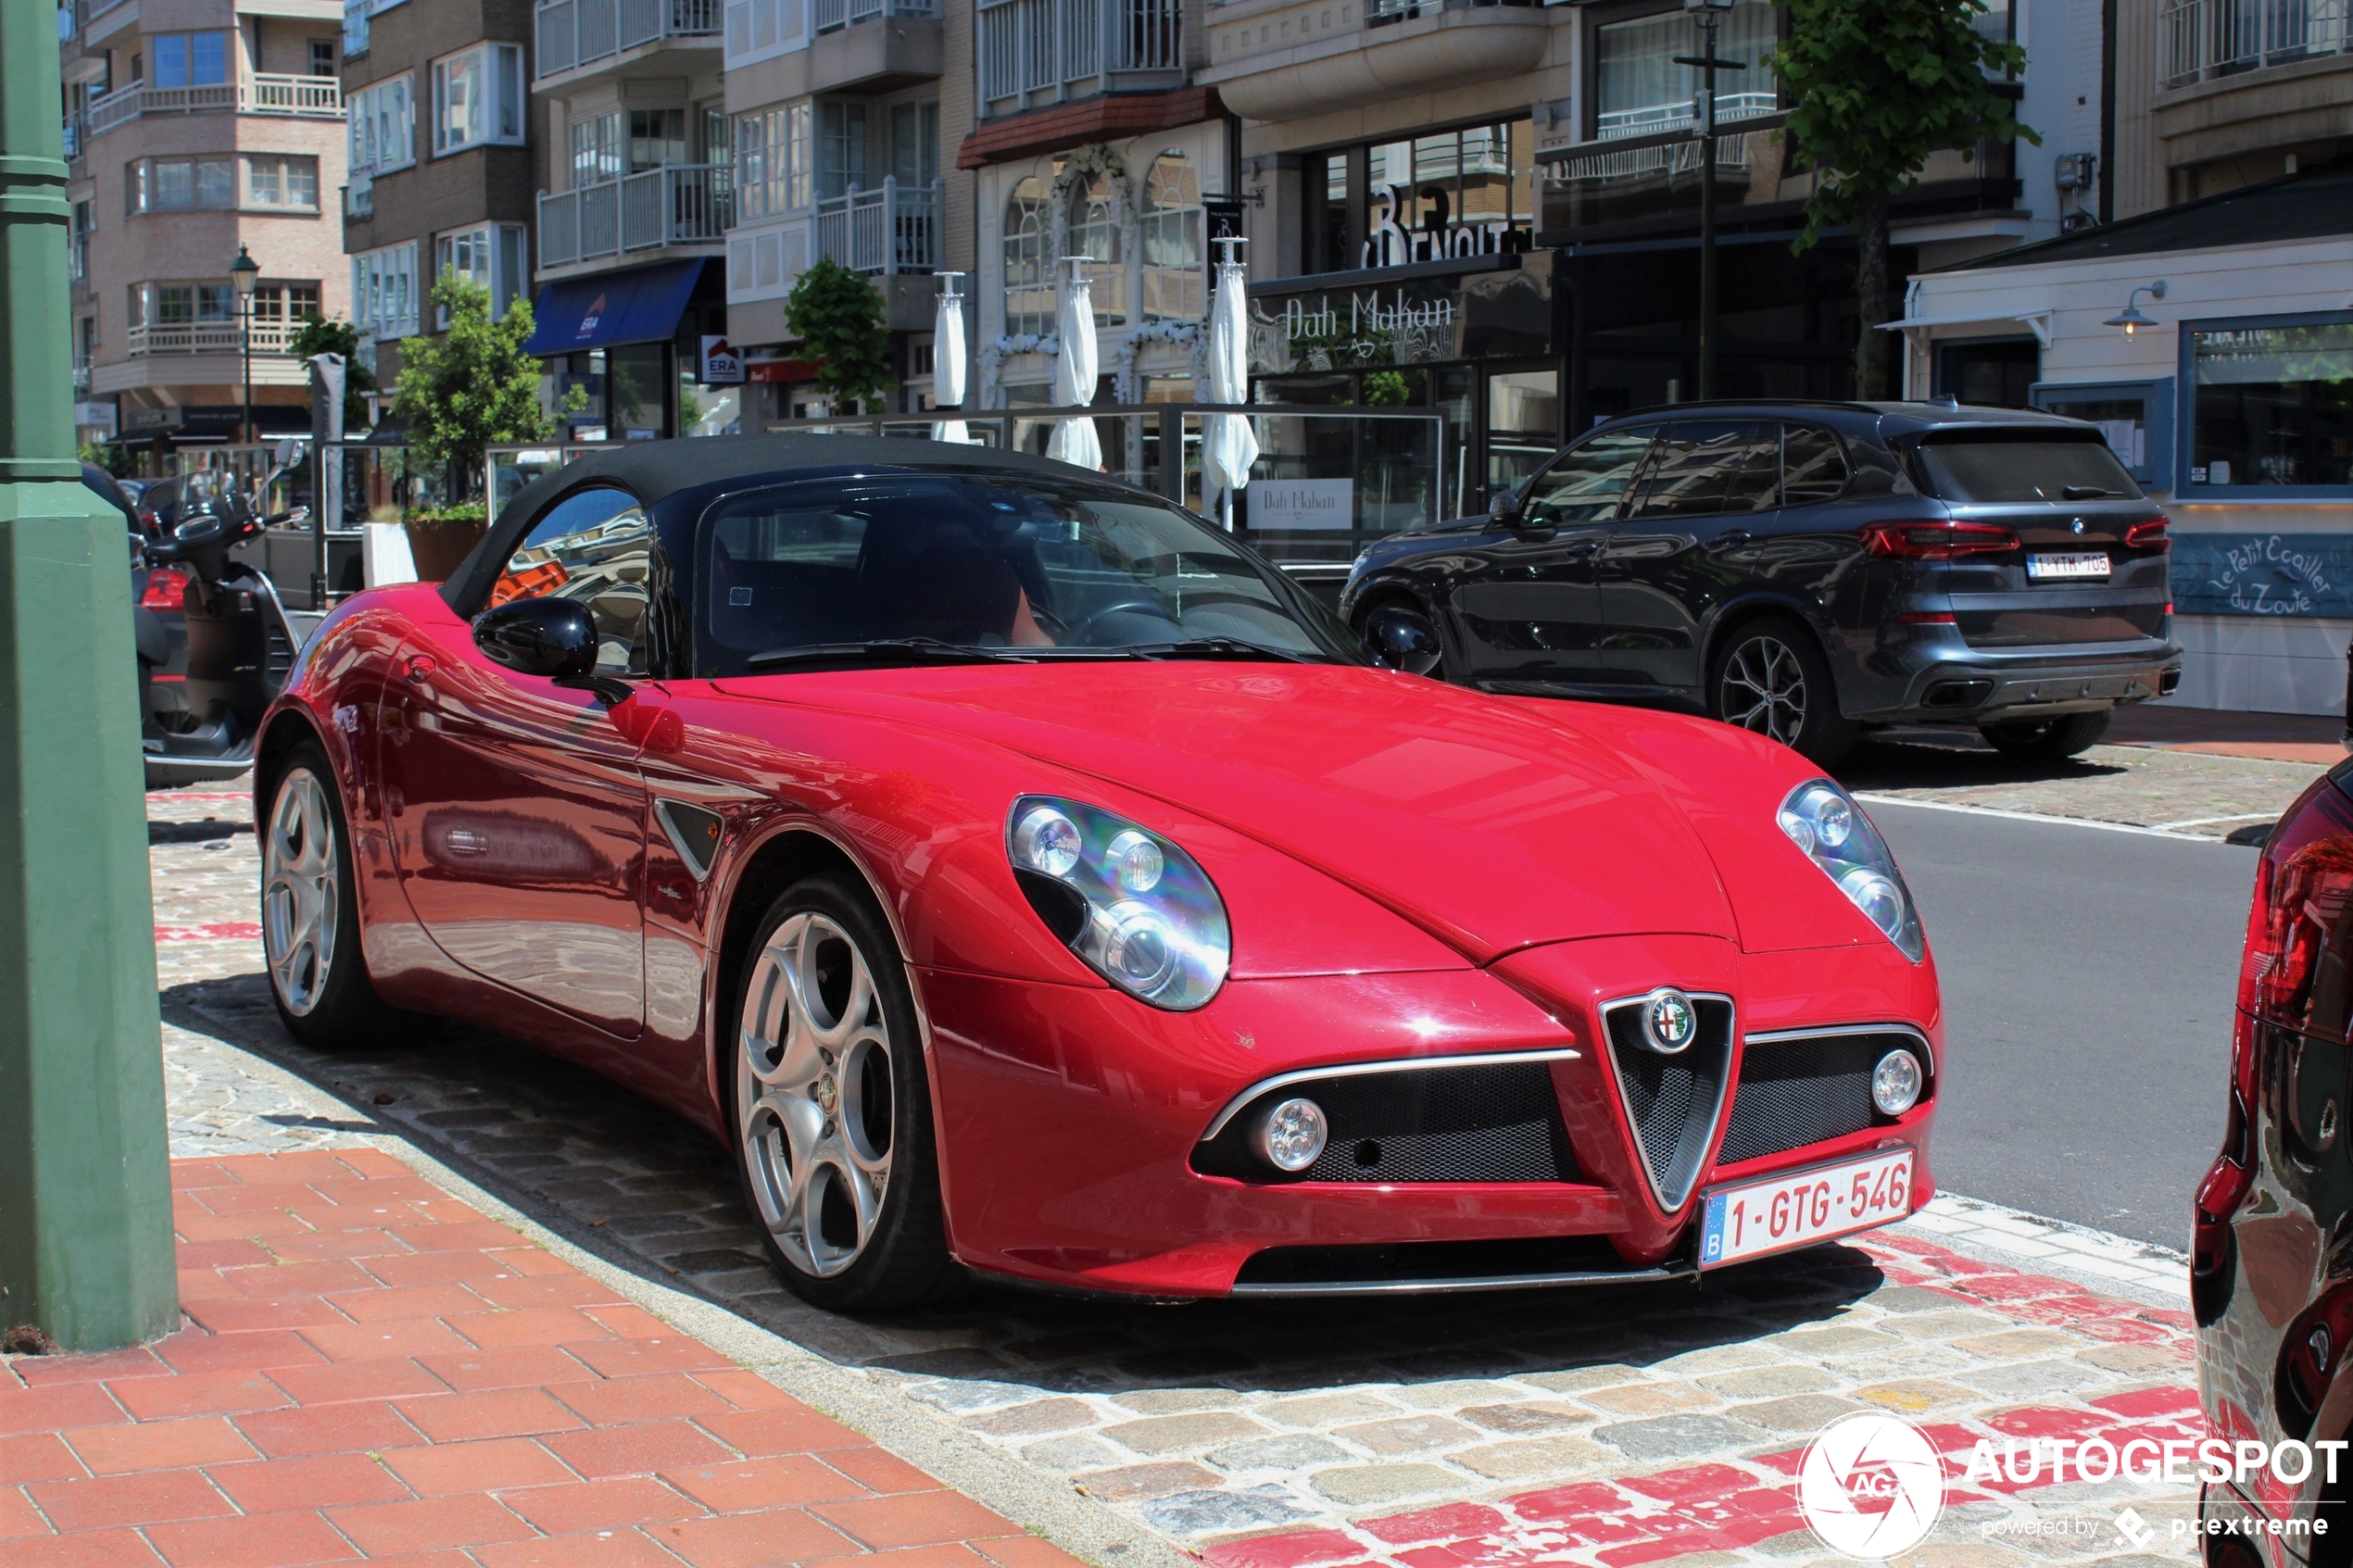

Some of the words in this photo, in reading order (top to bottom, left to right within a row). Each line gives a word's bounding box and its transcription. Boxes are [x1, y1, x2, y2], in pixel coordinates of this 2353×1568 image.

[580, 316, 598, 331] ERA
[1286, 295, 1337, 340] Dah
[1351, 288, 1454, 334] Makan
[710, 360, 737, 371] ERA
[1265, 490, 1287, 509] Dah
[1292, 490, 1335, 509] Makan
[2208, 571, 2234, 590] Le
[2225, 538, 2264, 573] Petit
[2266, 534, 2331, 593] Ecailler
[2231, 583, 2251, 610] du
[2251, 583, 2311, 614] Zoute
[1707, 1234, 1720, 1257] B
[1732, 1162, 1907, 1248] 1-GTG-546
